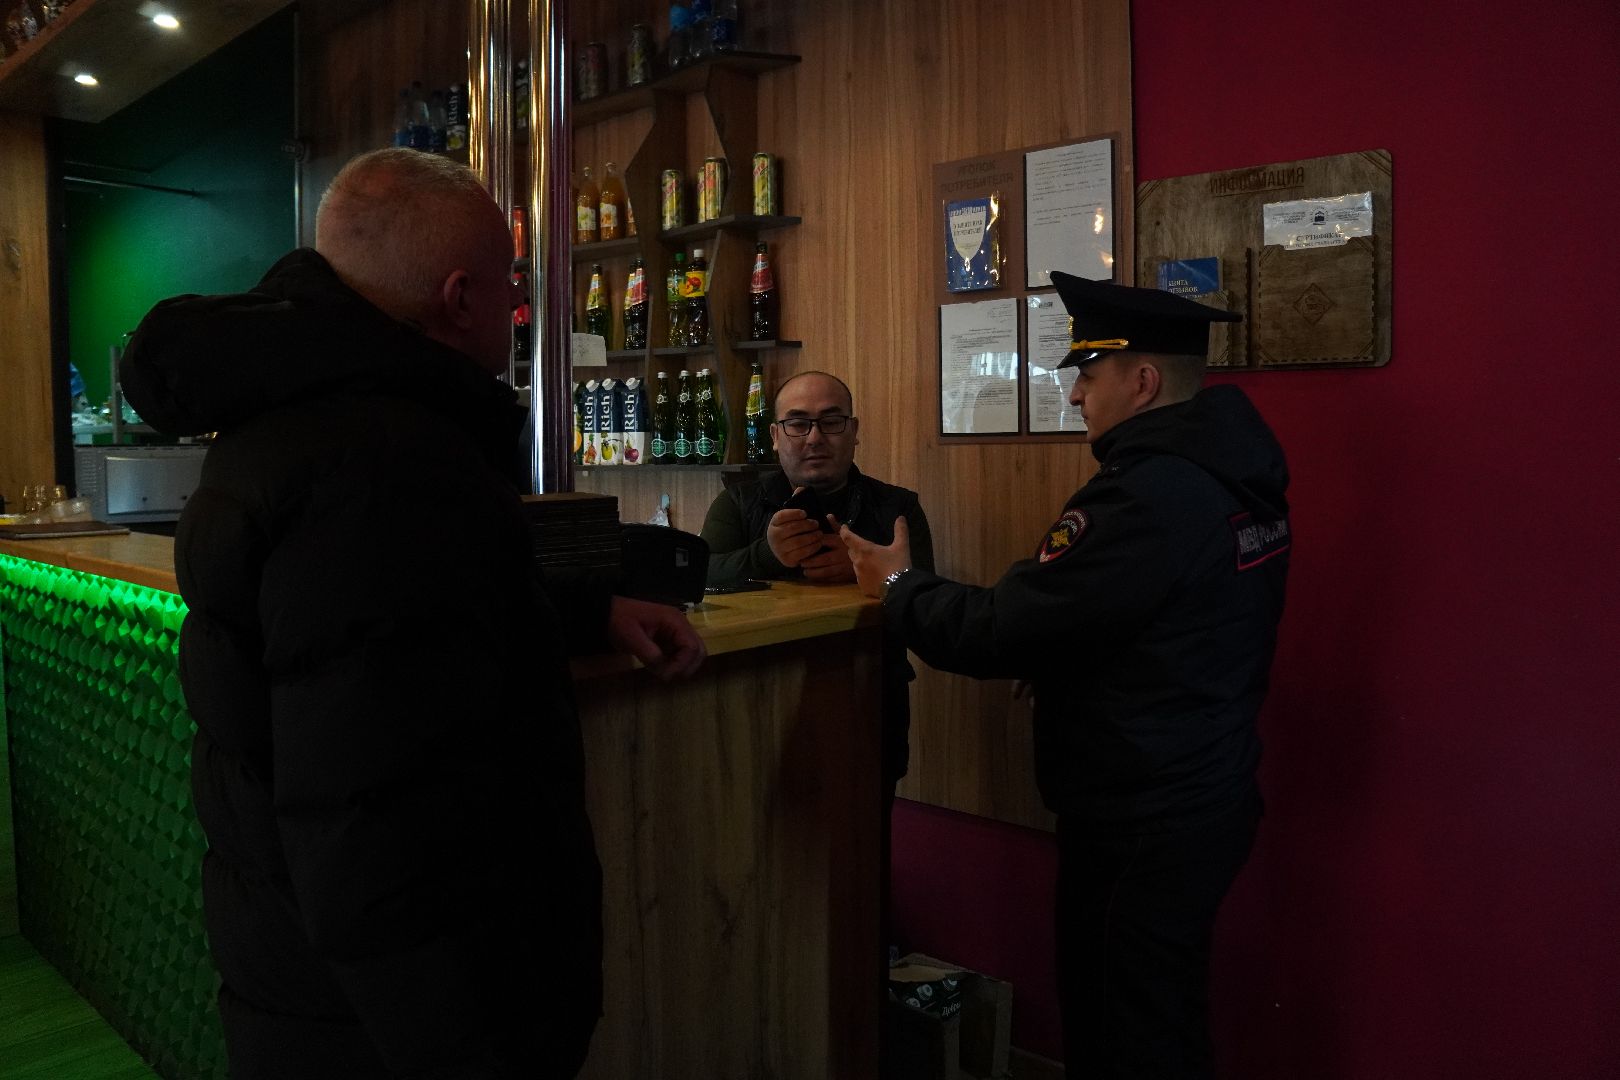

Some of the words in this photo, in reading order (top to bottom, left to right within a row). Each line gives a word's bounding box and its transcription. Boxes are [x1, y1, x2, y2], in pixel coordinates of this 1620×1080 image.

[940, 172, 1015, 194] ПОТРЕБИТЕЛЯ
[1209, 166, 1305, 194] ИНФОРМАЦИЯ
[584, 396, 594, 431] Rich
[600, 395, 611, 431] Rich
[625, 394, 635, 431] Rich
